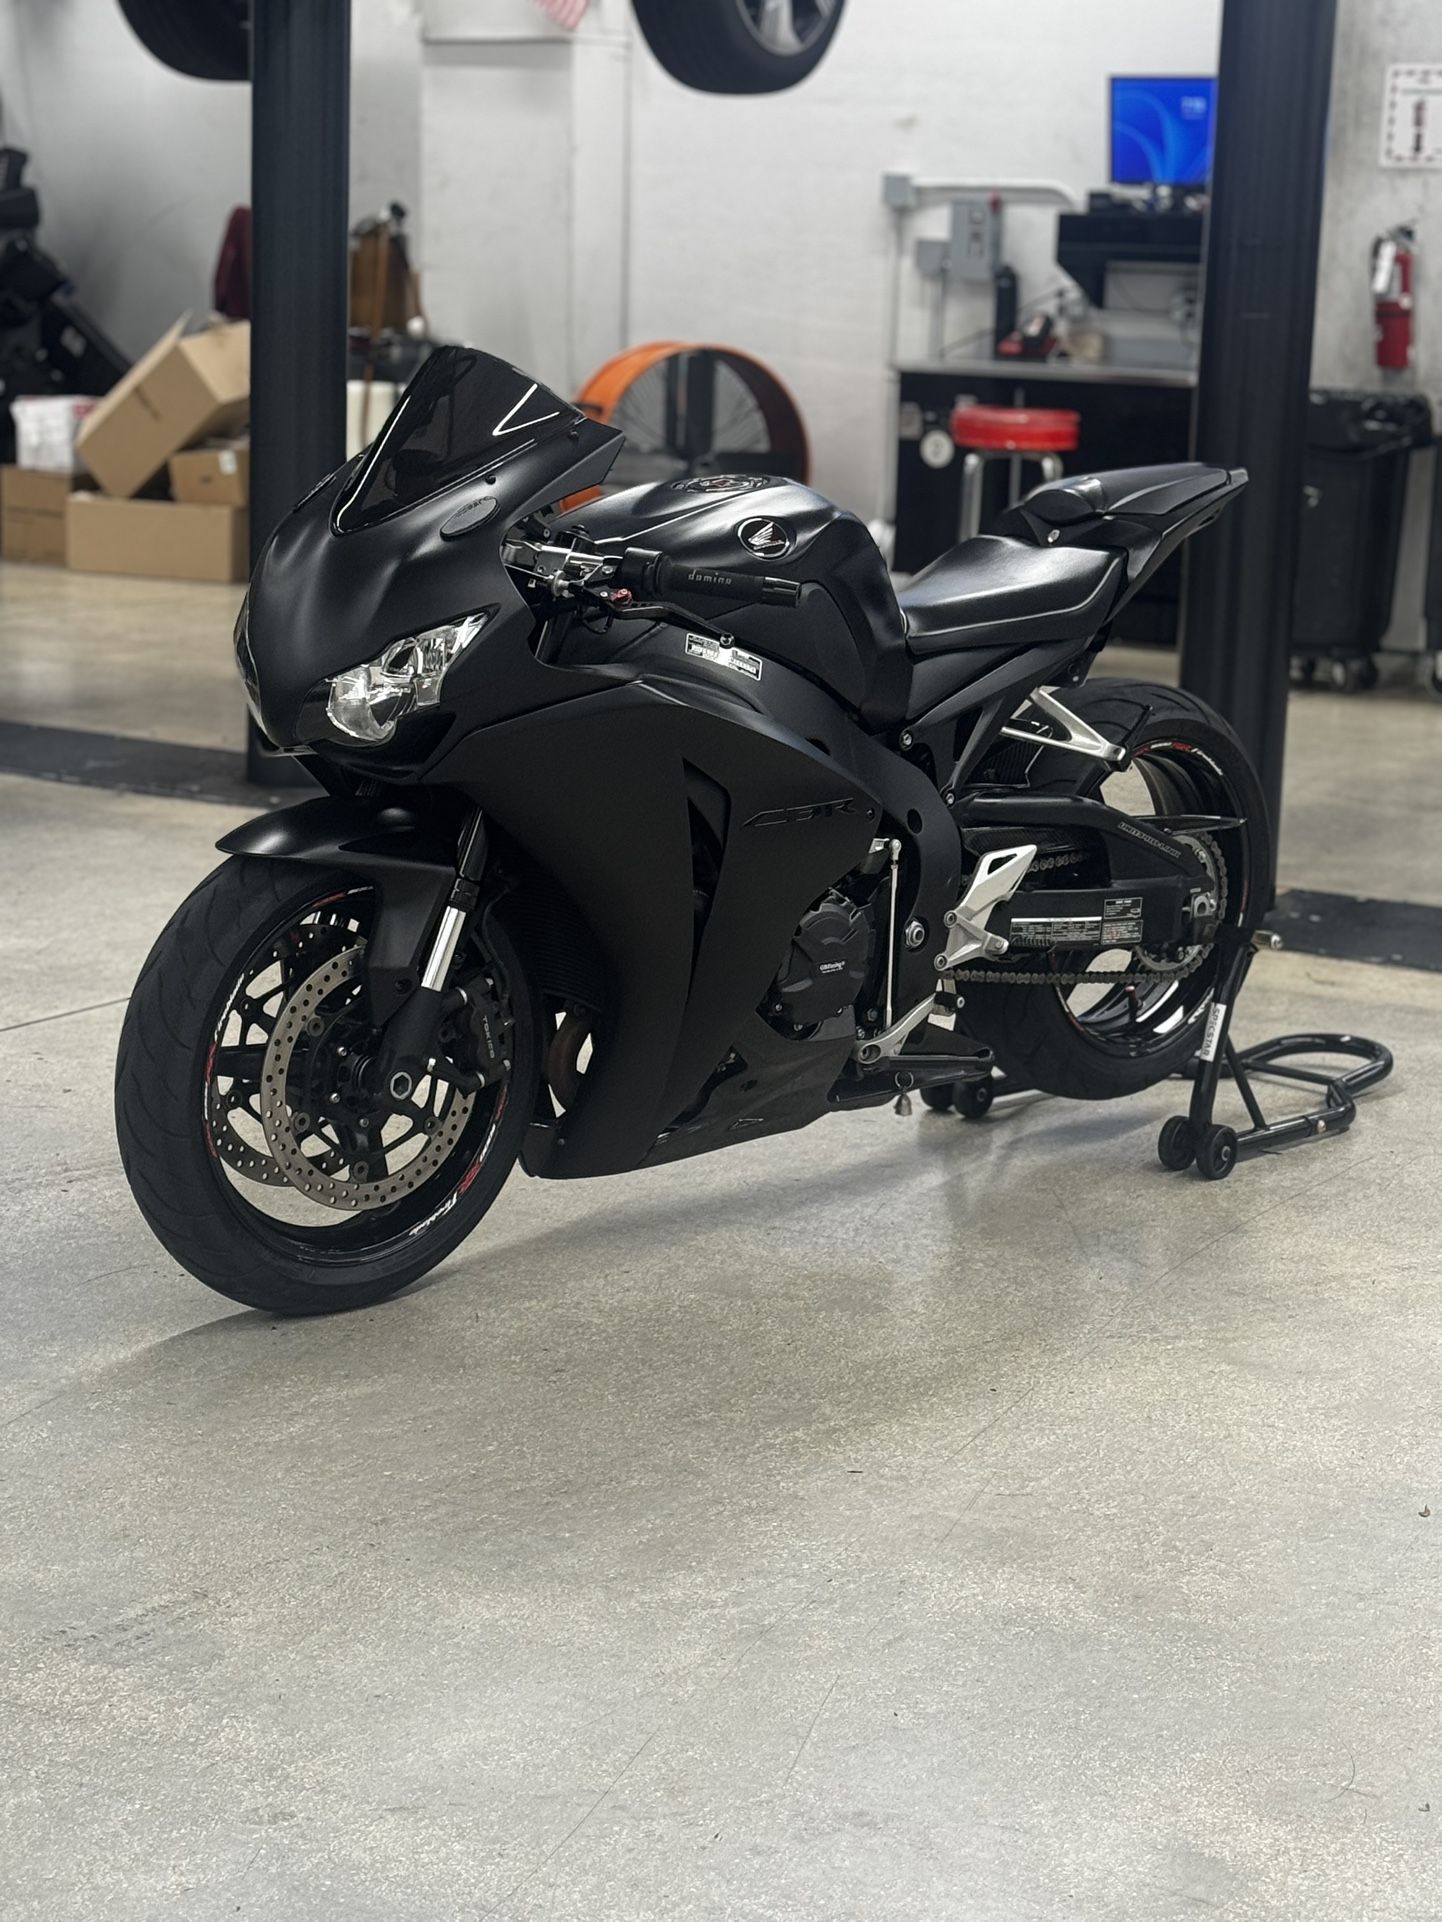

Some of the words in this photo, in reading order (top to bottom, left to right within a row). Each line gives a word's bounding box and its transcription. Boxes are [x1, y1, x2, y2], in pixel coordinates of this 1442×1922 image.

[687, 568, 733, 586] domino
[482, 1015, 496, 1059] TOKICO
[1202, 1008, 1221, 1057] SPECSTAR
